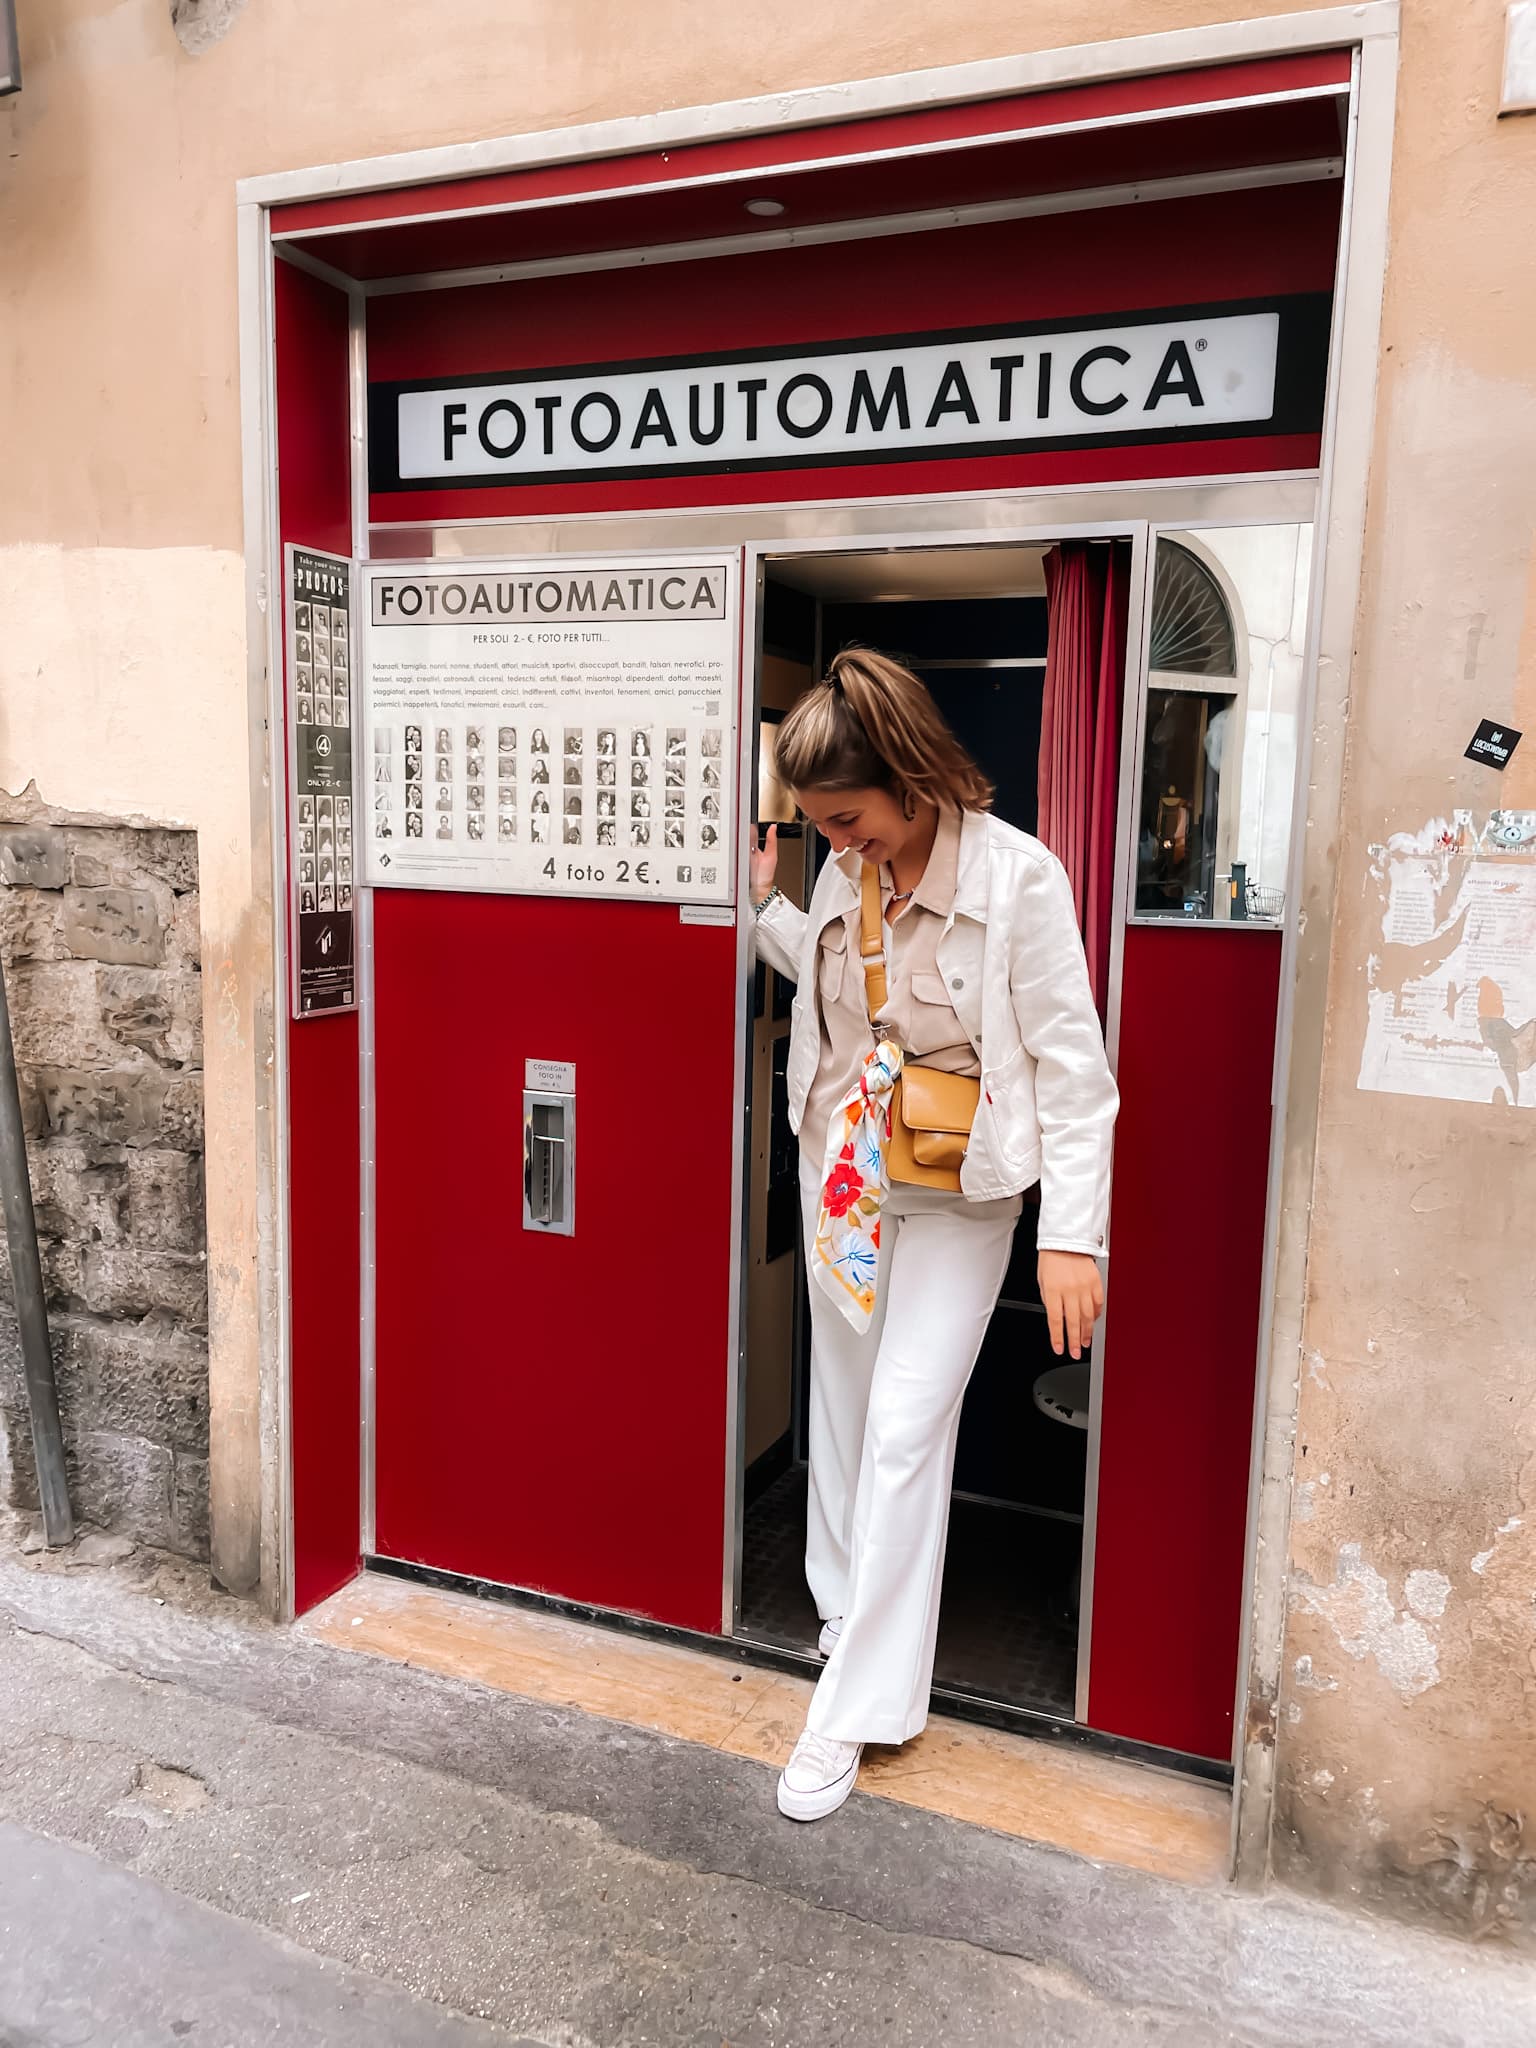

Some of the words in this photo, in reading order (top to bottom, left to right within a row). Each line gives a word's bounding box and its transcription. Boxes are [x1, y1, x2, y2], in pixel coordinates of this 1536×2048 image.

[297, 568, 343, 596] PHOTOS
[473, 634, 487, 644] PER
[490, 634, 509, 644] SOLI
[538, 633, 560, 643] FOTO
[564, 633, 579, 642] PER
[318, 738, 329, 753] 4
[307, 779, 325, 787] ONLY
[542, 857, 556, 879] 4
[567, 864, 605, 882] foto
